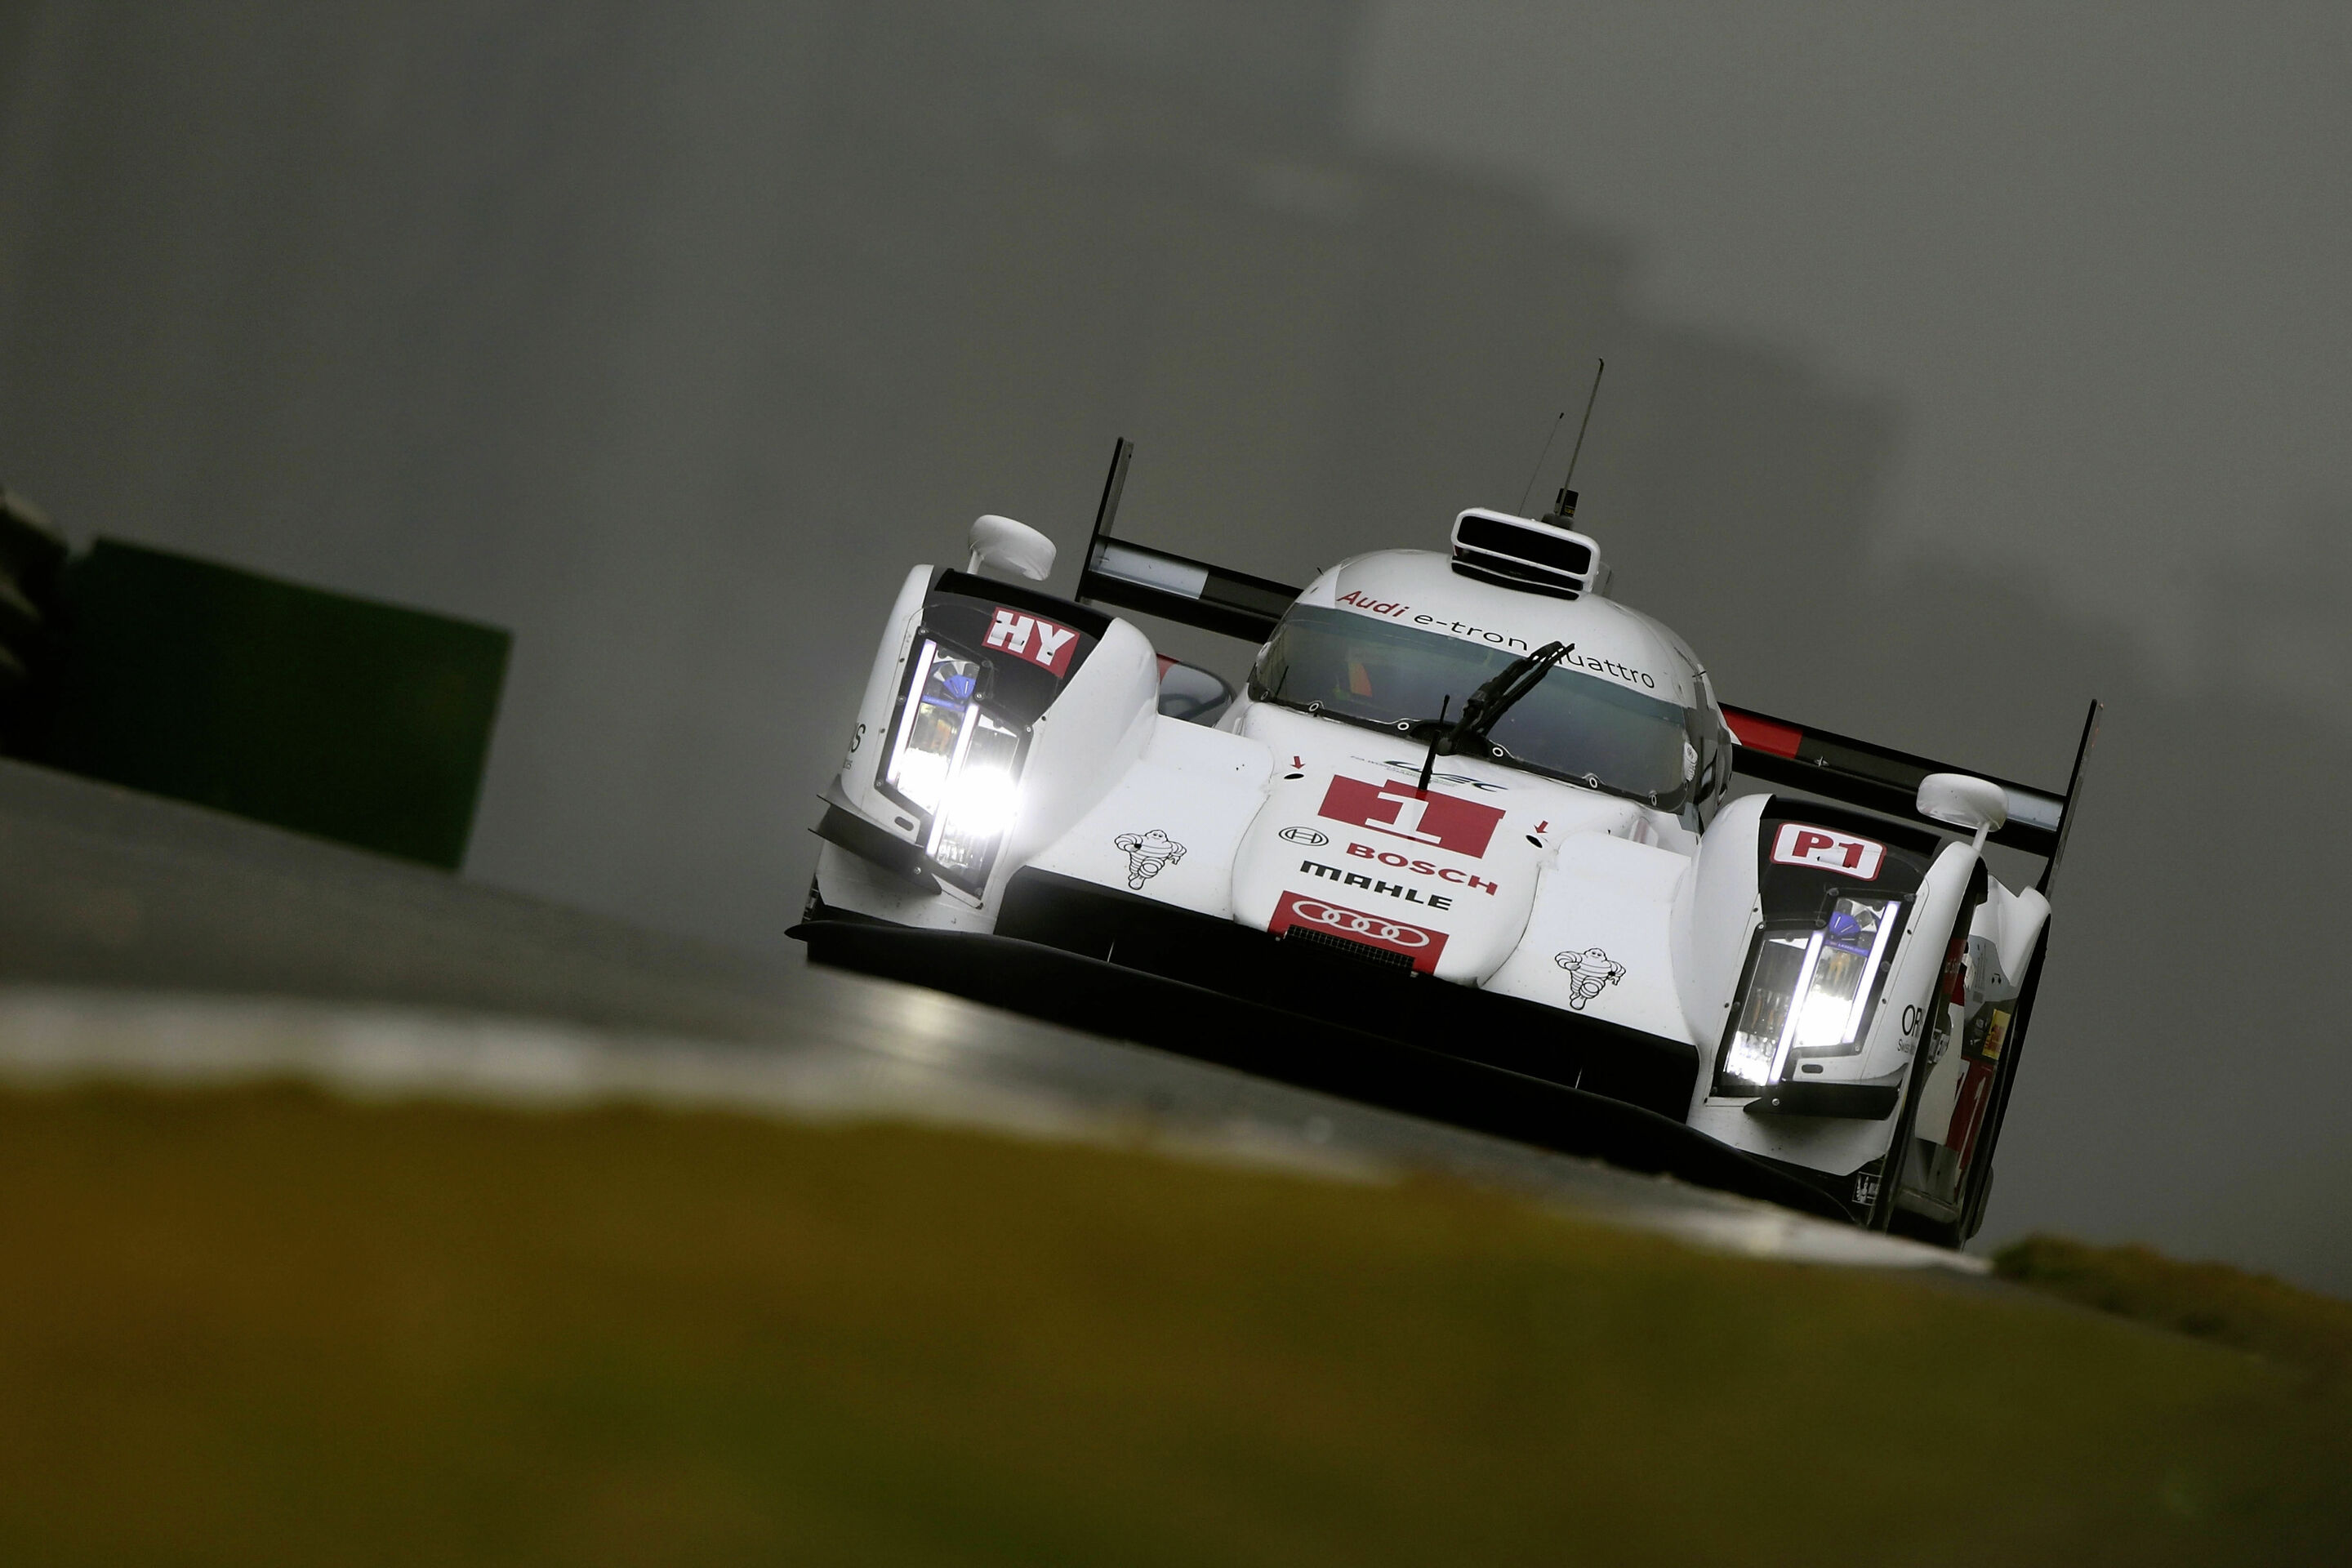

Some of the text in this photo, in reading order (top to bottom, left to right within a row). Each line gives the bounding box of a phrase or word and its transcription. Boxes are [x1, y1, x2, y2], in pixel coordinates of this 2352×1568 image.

[987, 609, 1076, 666] HY
[1338, 589, 1655, 689] Audi e-tron uattro
[1365, 791, 1441, 845] 1
[1346, 842, 1499, 897] BOSCH
[1792, 831, 1865, 869] P1
[1299, 860, 1454, 912] MAHLE
